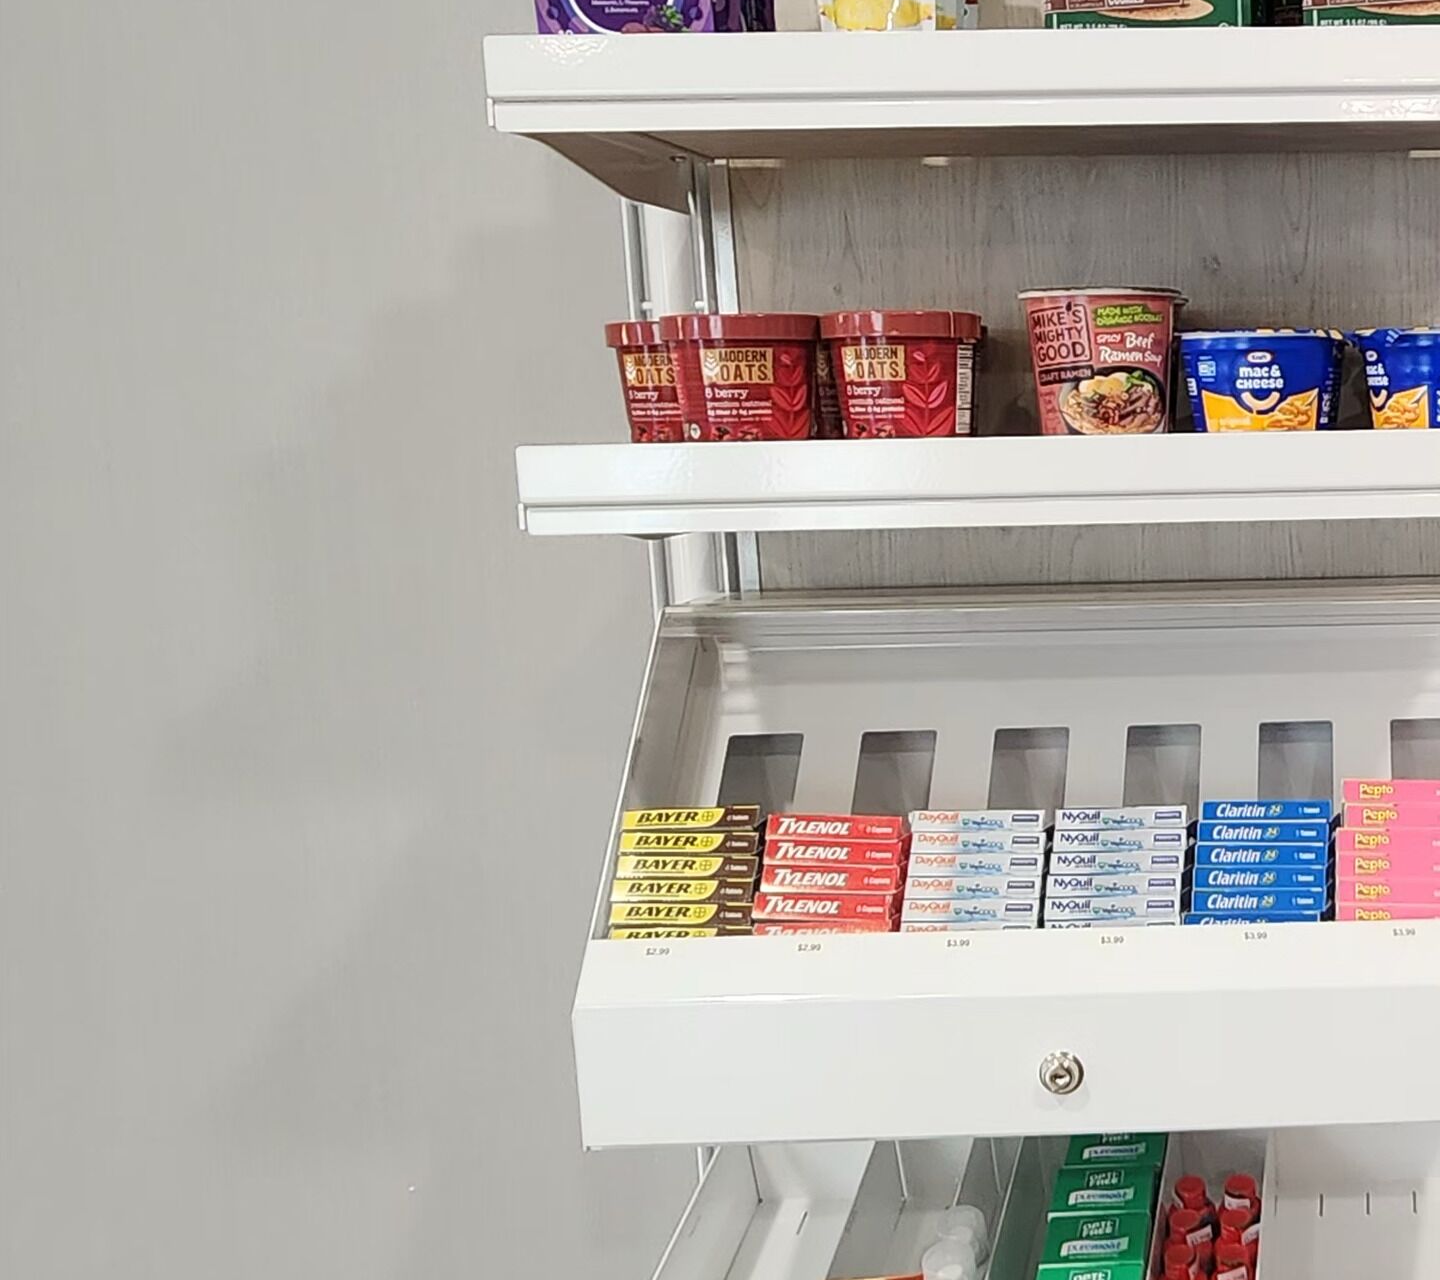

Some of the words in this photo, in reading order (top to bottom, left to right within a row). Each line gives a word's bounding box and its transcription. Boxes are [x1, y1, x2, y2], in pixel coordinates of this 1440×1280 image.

[1123, 331, 1155, 349] Beef
[719, 349, 768, 363] MODERN
[1037, 341, 1086, 363] GOOD
[1099, 346, 1144, 363] Ramen
[720, 363, 771, 382] OATS
[714, 387, 749, 400] berry
[1359, 783, 1394, 796] Pepto
[918, 811, 960, 822] DayQuil
[1062, 811, 1101, 821] NyQuil
[1216, 803, 1265, 818] Claritin
[637, 811, 698, 825] BAYER
[776, 818, 851, 836] TYLENOL
